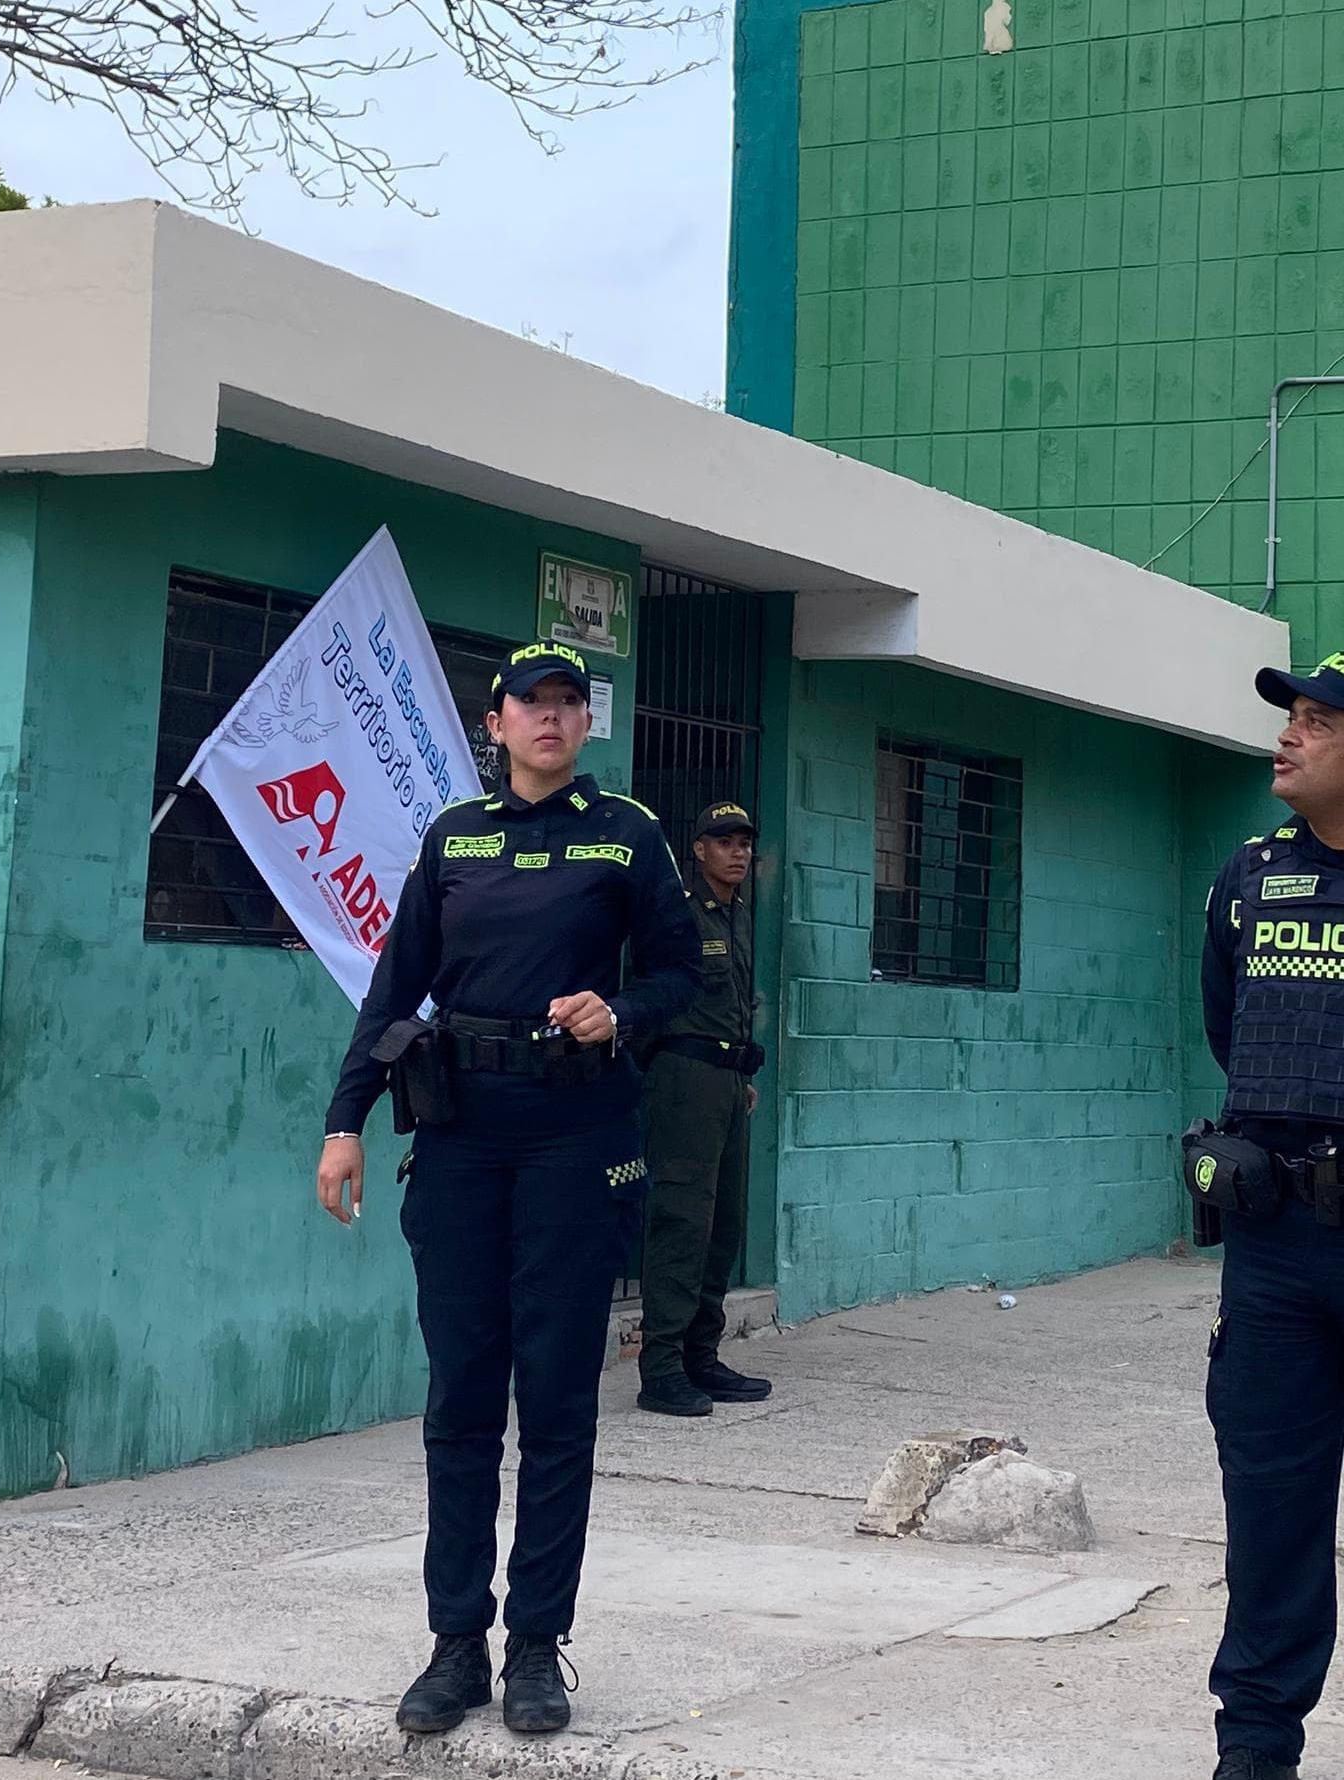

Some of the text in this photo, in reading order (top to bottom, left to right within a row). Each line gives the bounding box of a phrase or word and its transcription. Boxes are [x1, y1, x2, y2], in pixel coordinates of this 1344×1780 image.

[510, 642, 585, 674] POLICÍA
[574, 604, 603, 628] SALIDA
[321, 620, 416, 807] Territorio
[368, 610, 452, 804] La Escuela
